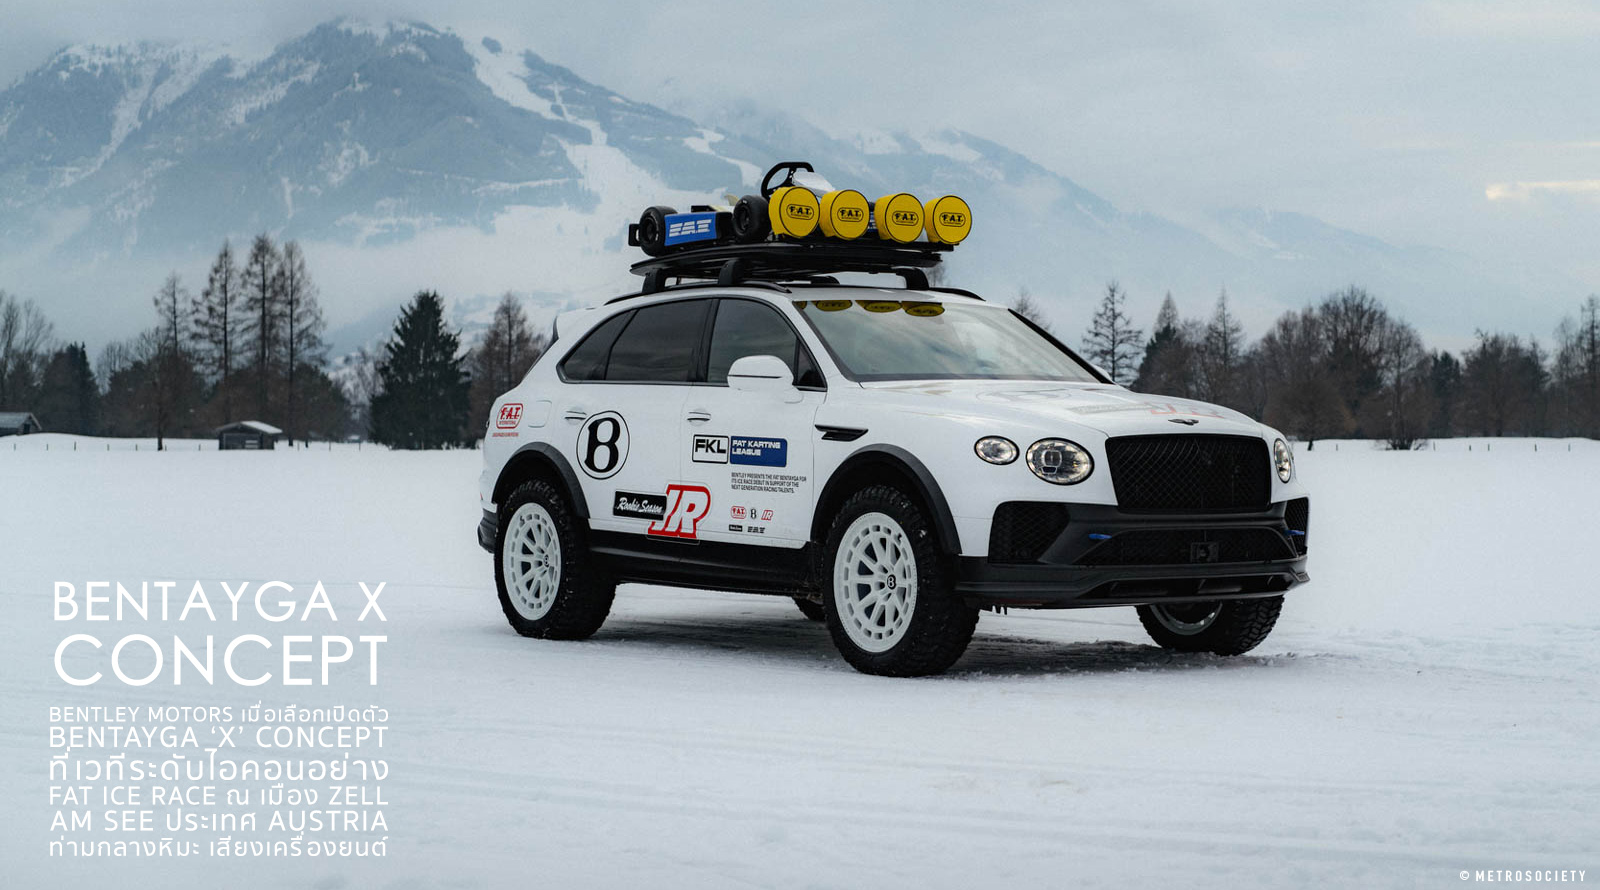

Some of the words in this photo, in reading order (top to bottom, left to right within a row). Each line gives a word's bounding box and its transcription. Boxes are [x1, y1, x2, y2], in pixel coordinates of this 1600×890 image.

[694, 439, 726, 453] FKL
[748, 441, 781, 449] KARTING
[731, 448, 761, 456] LEAGUE
[616, 497, 640, 511] Rookie
[639, 500, 663, 514] Season
